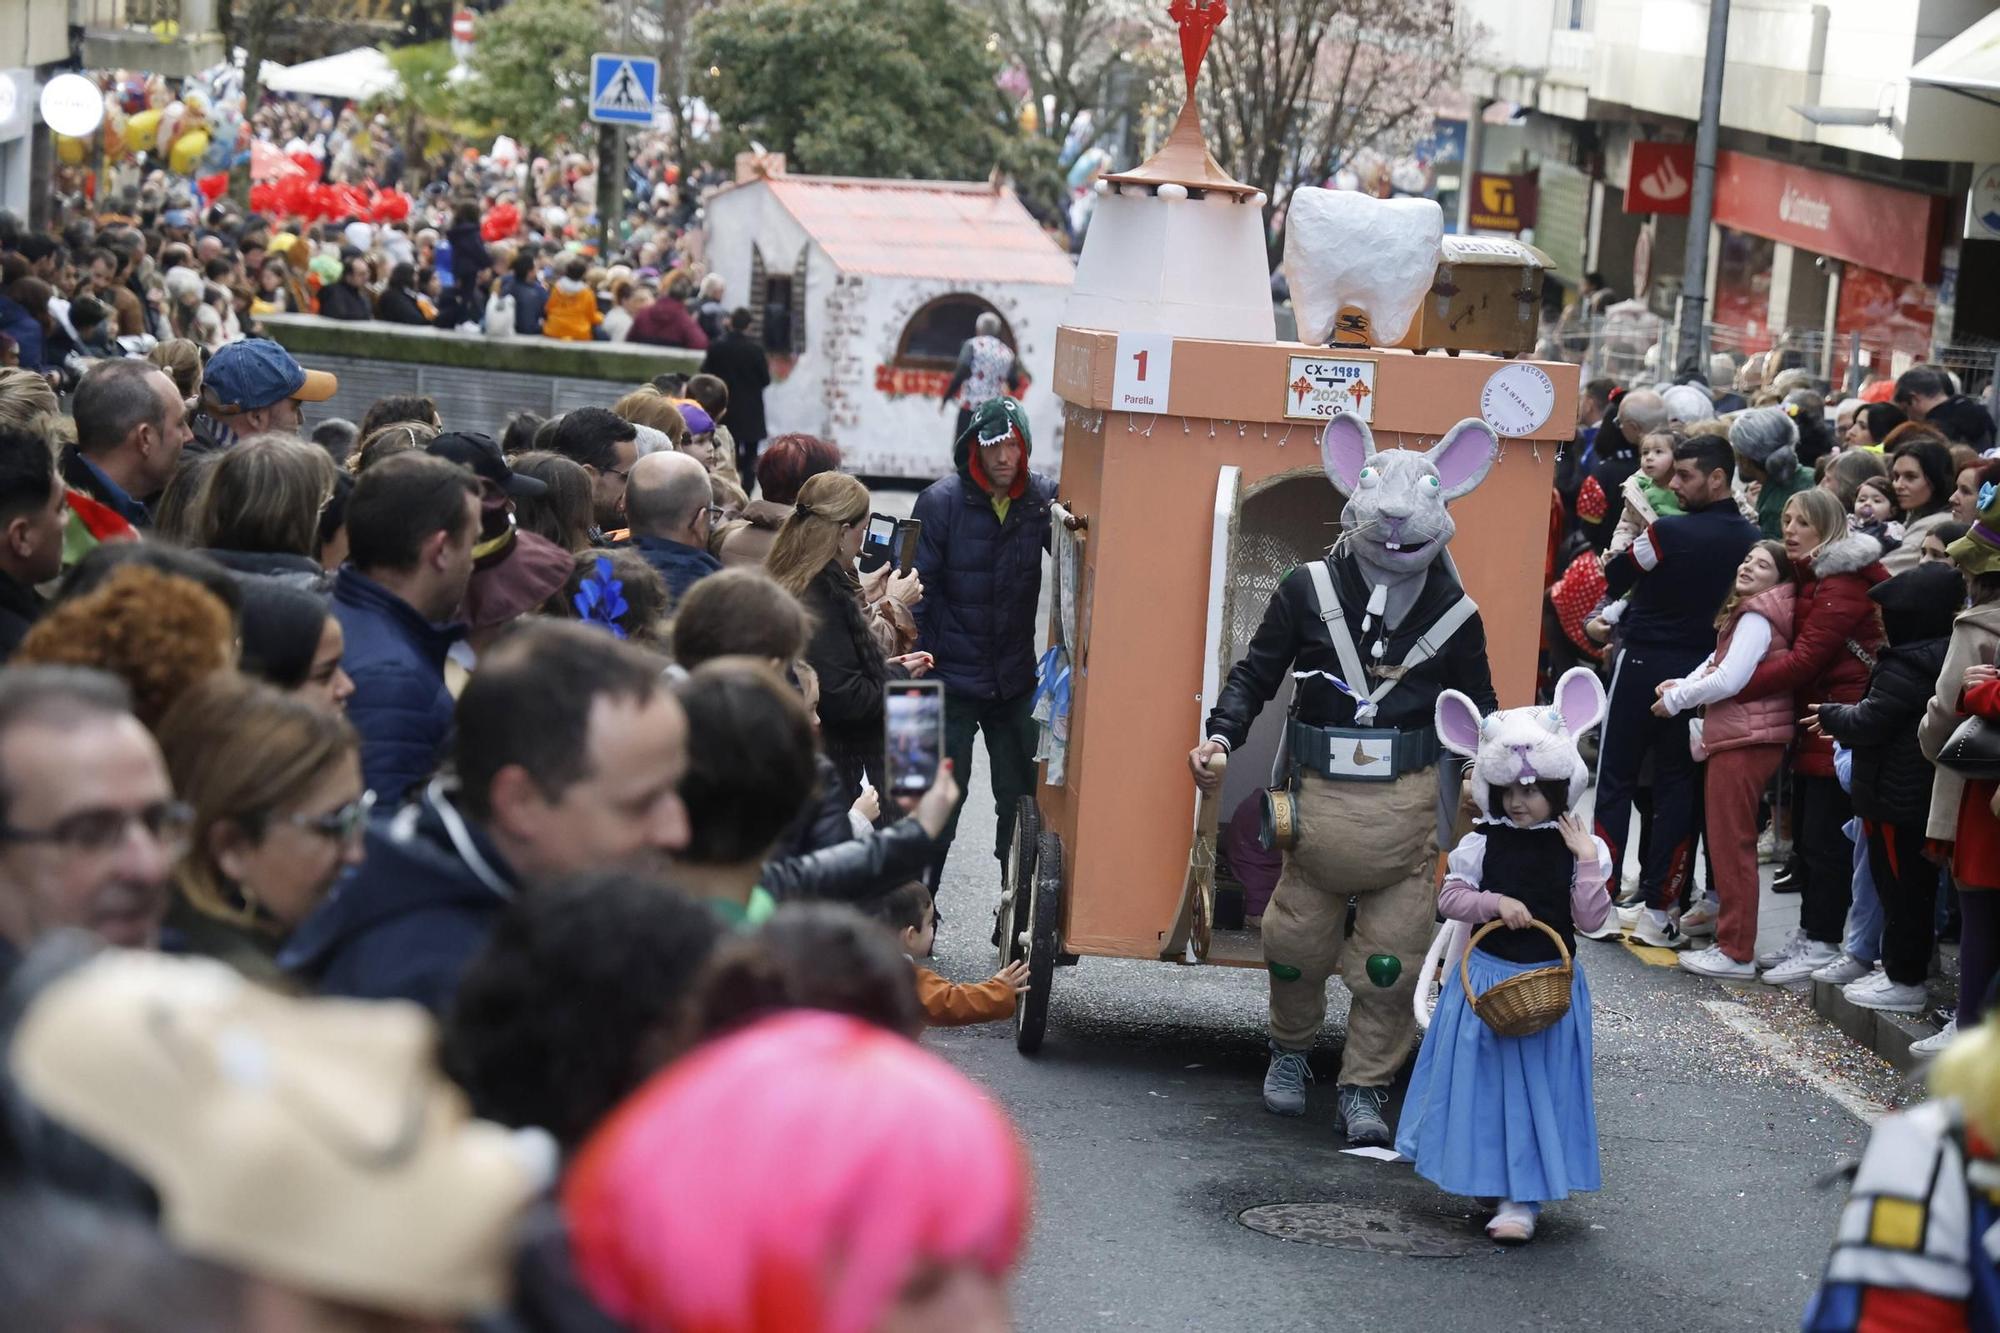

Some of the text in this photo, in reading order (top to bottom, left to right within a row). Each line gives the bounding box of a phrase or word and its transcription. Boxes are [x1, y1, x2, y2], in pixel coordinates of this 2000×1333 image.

[1133, 350, 1148, 381] 1
[1124, 394, 1154, 405] Parella
[1312, 388, 1349, 403] 2024
